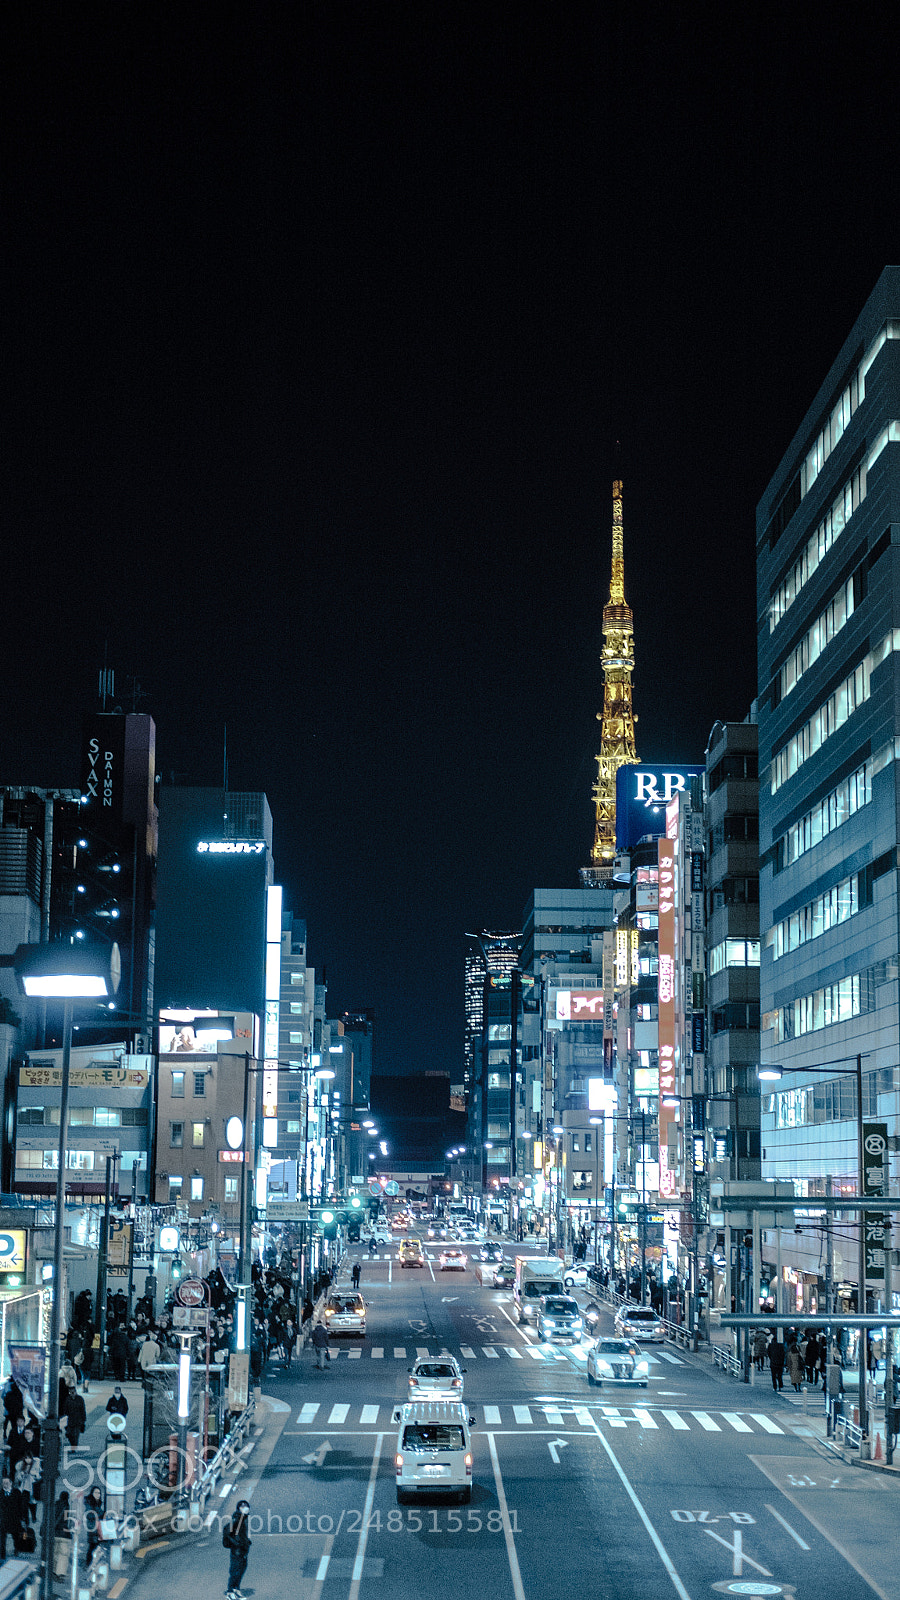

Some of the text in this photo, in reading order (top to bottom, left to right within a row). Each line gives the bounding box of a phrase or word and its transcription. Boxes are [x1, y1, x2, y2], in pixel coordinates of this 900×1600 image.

[87, 738, 99, 797] SVAX
[103, 751, 114, 807] DAIMON
[634, 772, 699, 802] RB
[660, 856, 674, 913] カラオケ
[102, 1070, 127, 1082] モリ
[660, 1045, 674, 1096] カラオ
[109, 1218, 124, 1241] P
[865, 1166, 886, 1269] 富港運
[117, 1267, 128, 1275] IN
